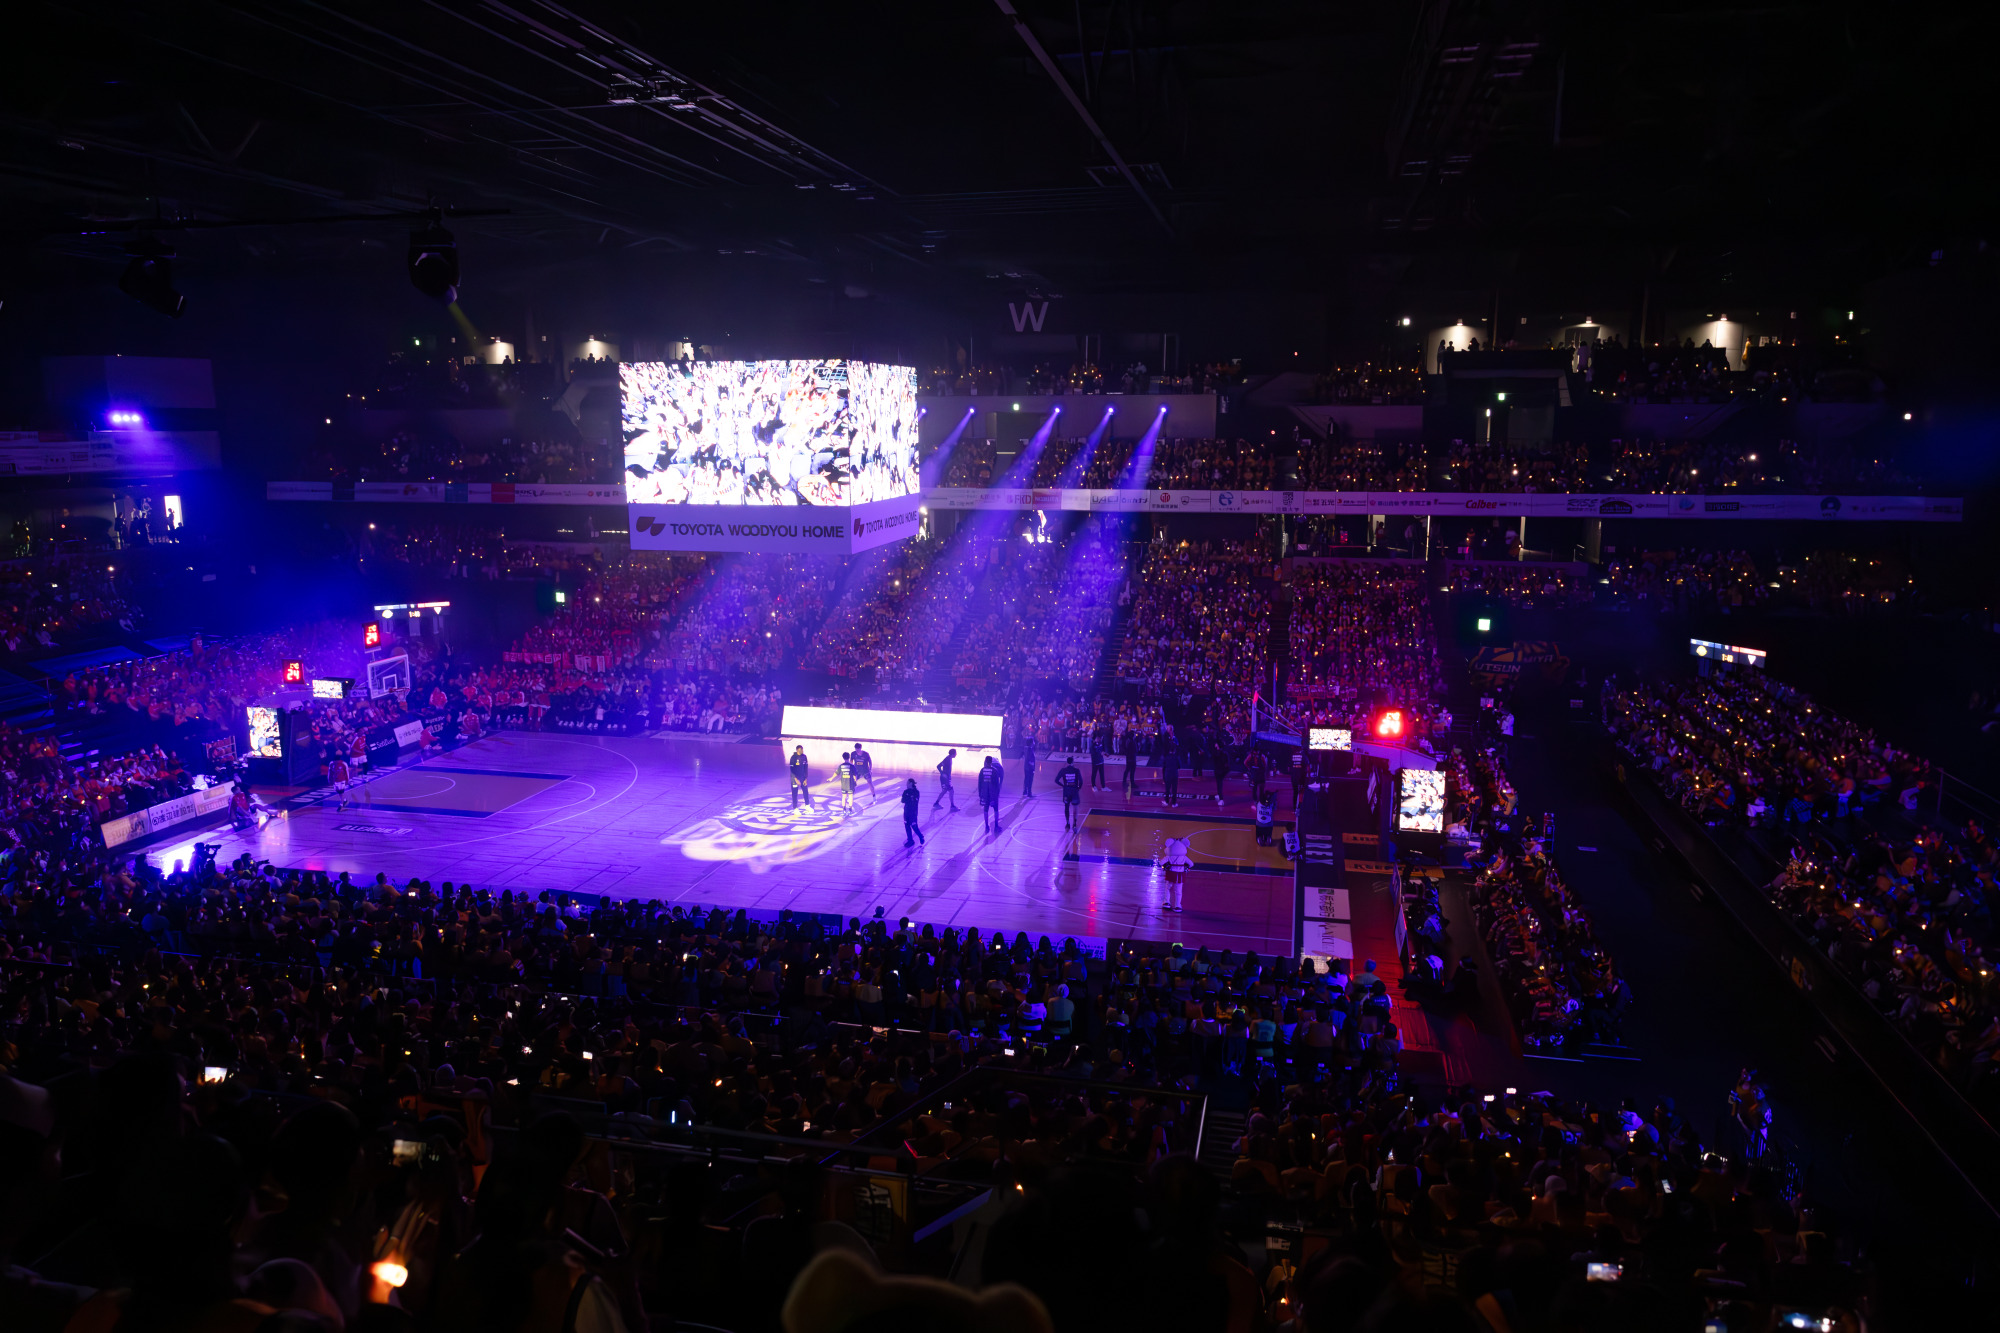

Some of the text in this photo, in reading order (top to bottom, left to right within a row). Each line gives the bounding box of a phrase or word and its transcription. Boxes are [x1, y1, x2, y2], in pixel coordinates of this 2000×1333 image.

[1008, 301, 1049, 332] W
[1465, 499, 1498, 510] Calbee
[866, 510, 918, 534] TOYOTA WOODYOU HOME
[670, 523, 845, 538] TOYOTA WOODYOU HOME
[366, 632, 379, 646] 24
[286, 668, 300, 681] 24
[1474, 662, 1522, 674] UTSUN
[1305, 833, 1334, 866] BREX
